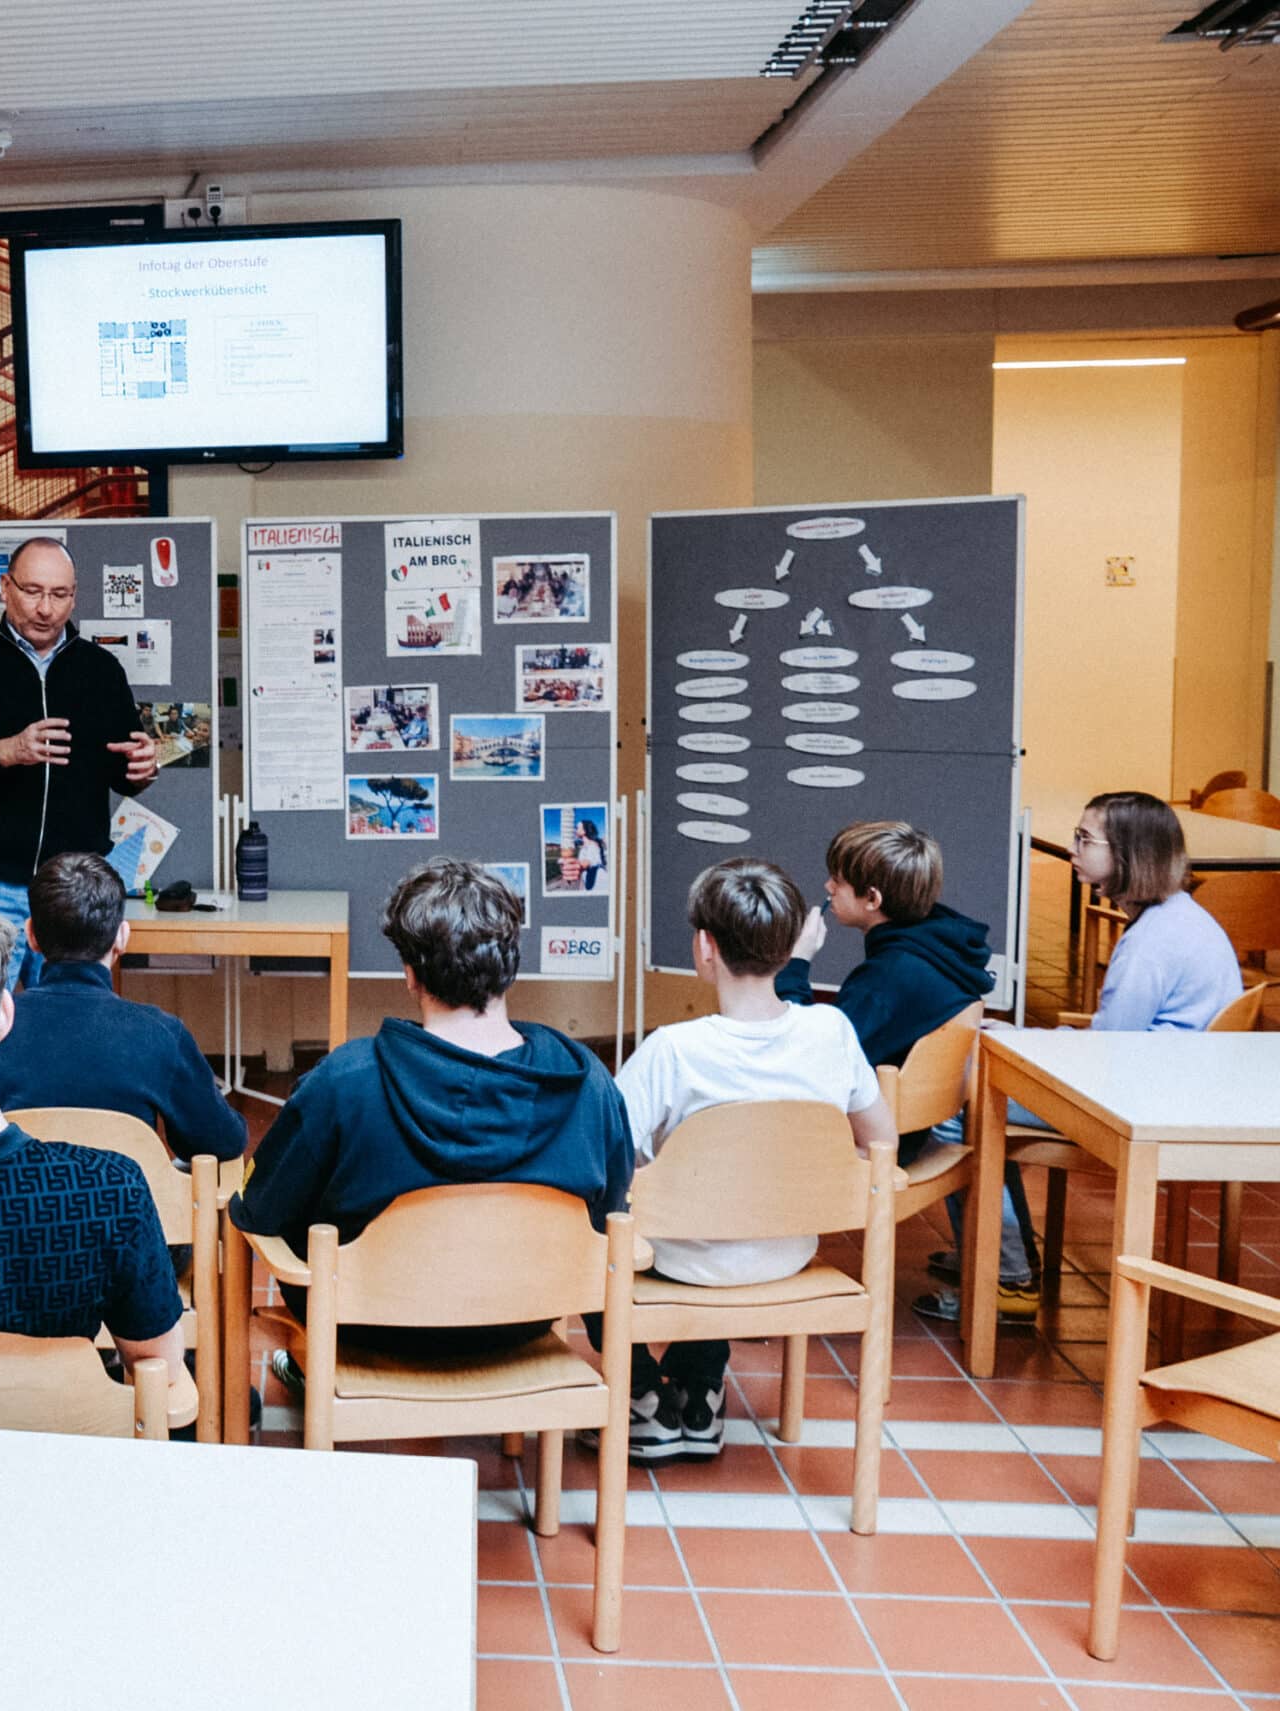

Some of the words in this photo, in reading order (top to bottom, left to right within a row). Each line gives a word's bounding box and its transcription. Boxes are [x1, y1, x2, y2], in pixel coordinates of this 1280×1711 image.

[138, 260, 181, 272] Infotag
[184, 258, 204, 270] der
[208, 256, 269, 269] Oberstufe
[254, 525, 339, 547] ITALIENISCH
[393, 534, 472, 548] ITALIENISCH
[409, 555, 428, 567] AM
[431, 554, 458, 566] BRG
[568, 939, 601, 955] BRG
